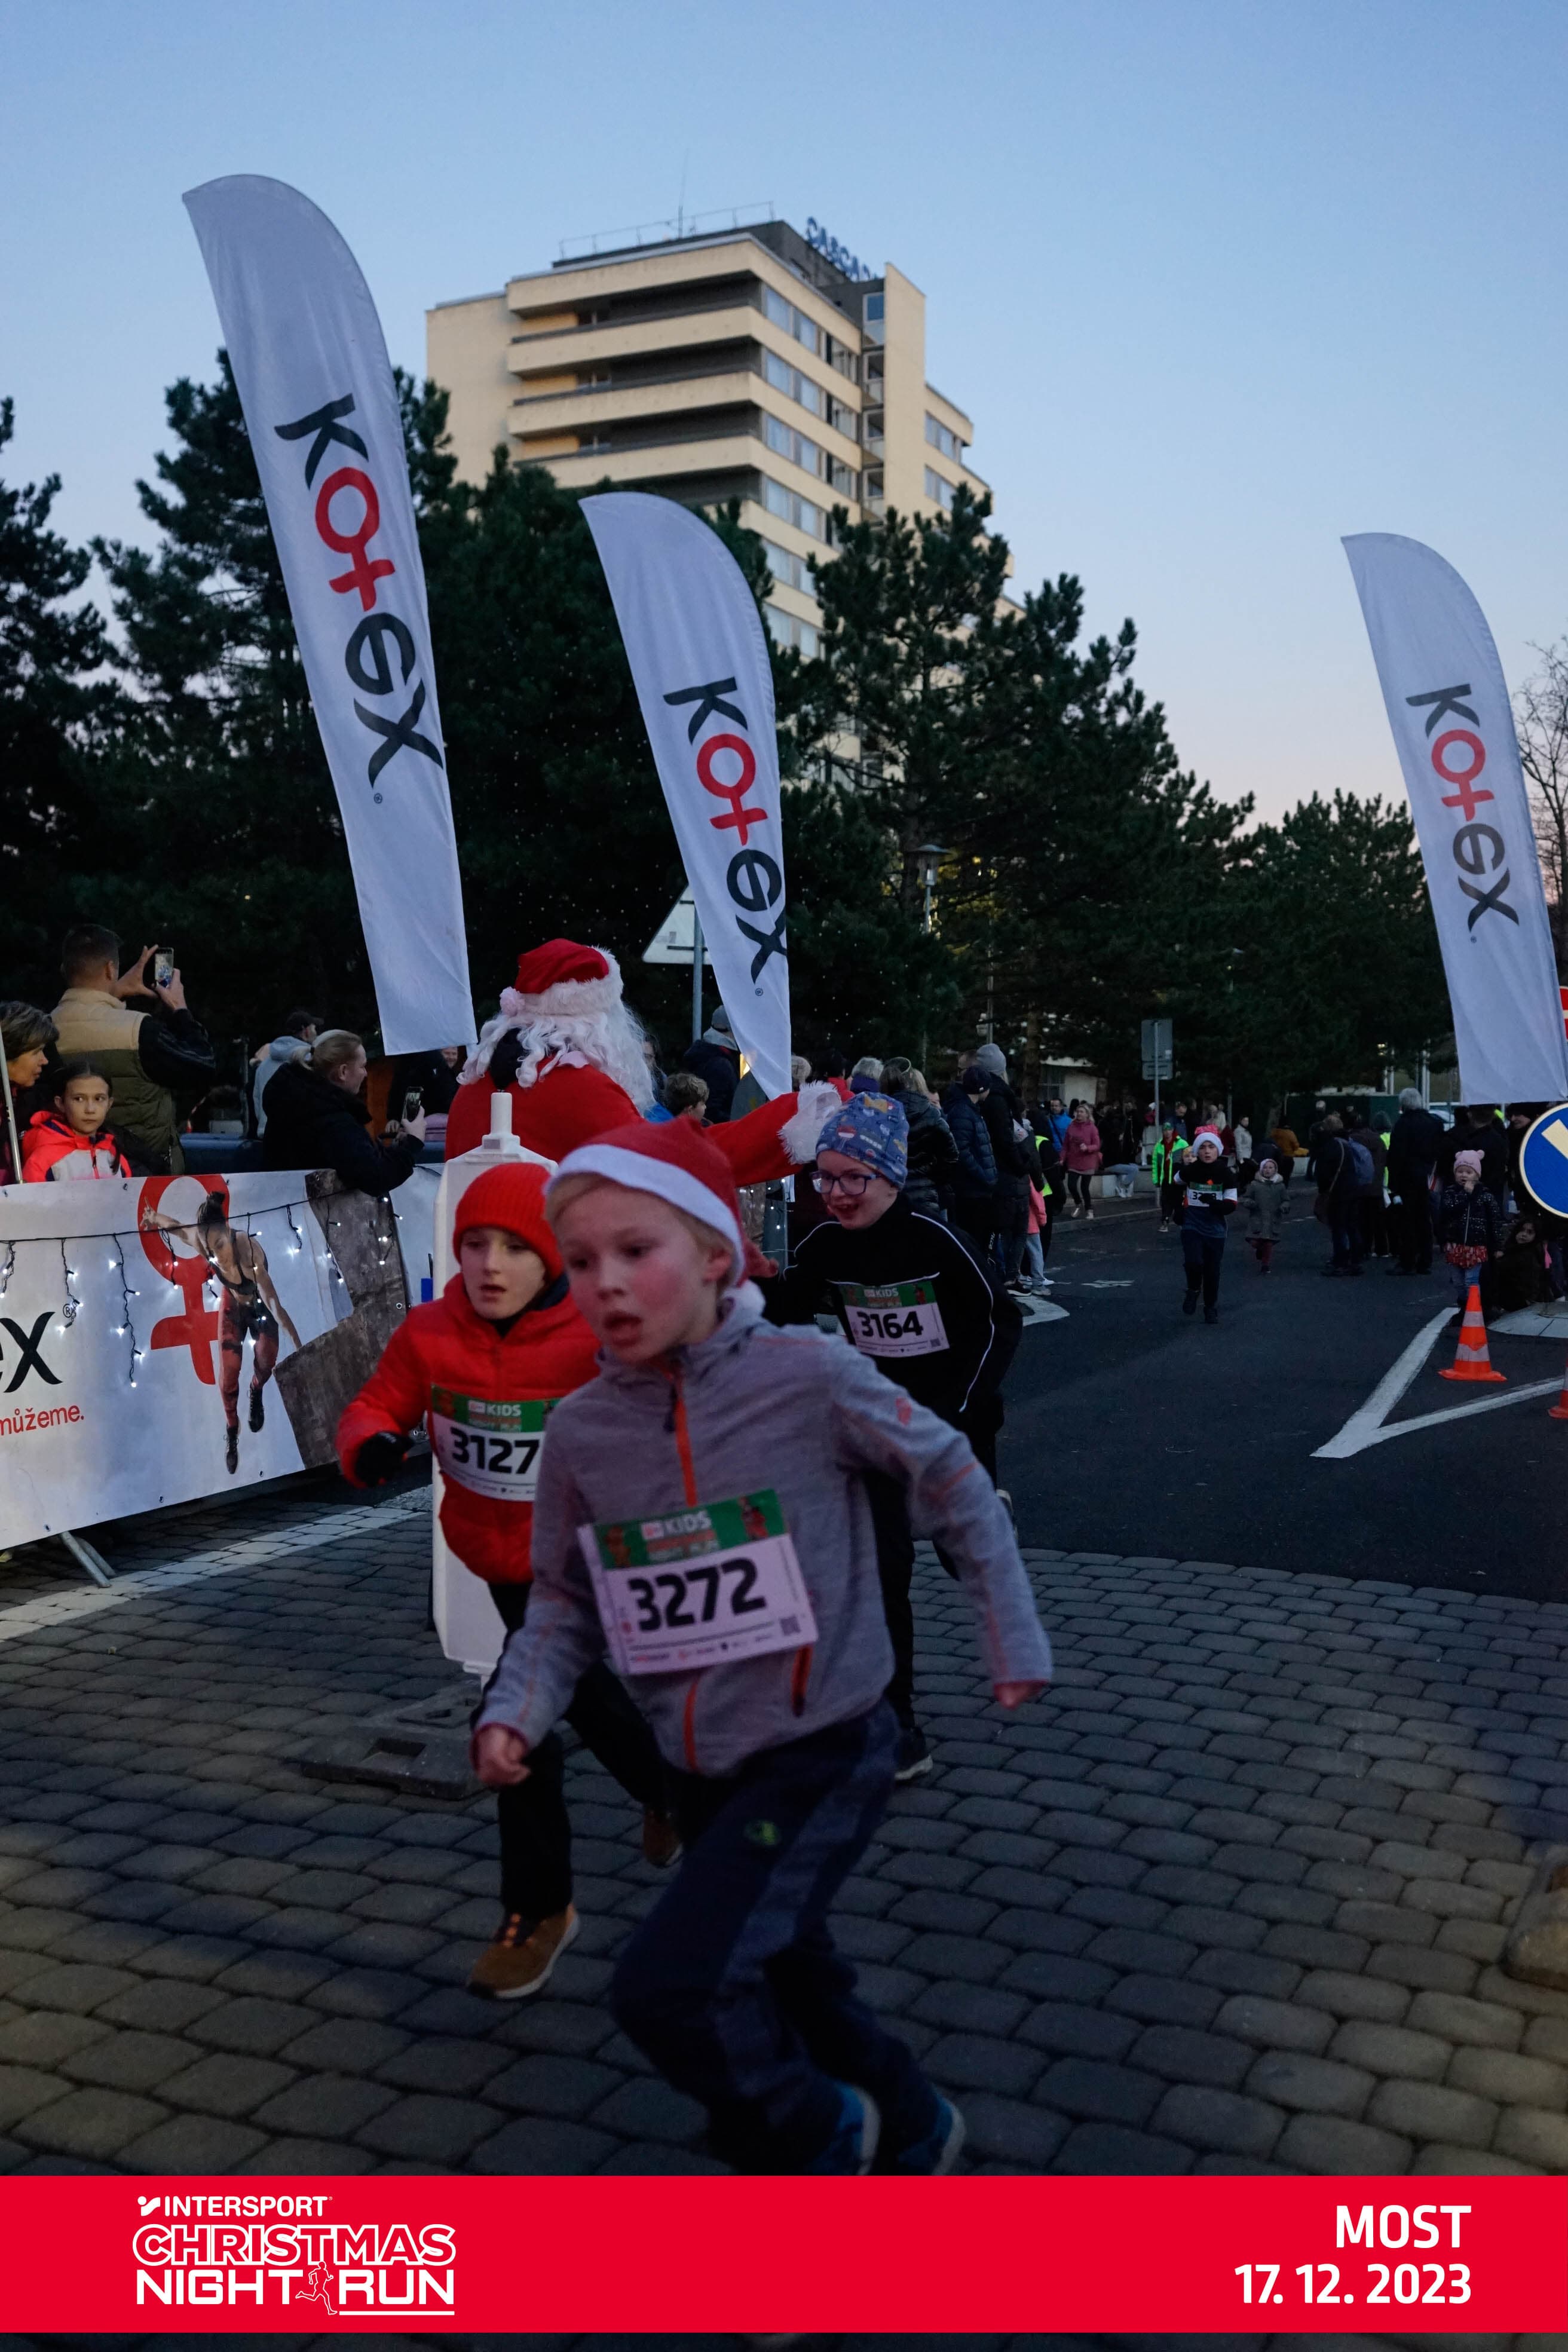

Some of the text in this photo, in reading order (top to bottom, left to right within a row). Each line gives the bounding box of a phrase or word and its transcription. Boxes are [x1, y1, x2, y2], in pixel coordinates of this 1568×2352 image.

[875, 1289, 899, 1297] KIDS
[856, 1310, 924, 1339] 3164
[486, 1404, 522, 1416] KIDS
[450, 1426, 540, 1474] 3127
[663, 1511, 712, 1535] KIDS
[627, 1557, 767, 1631] 3272
